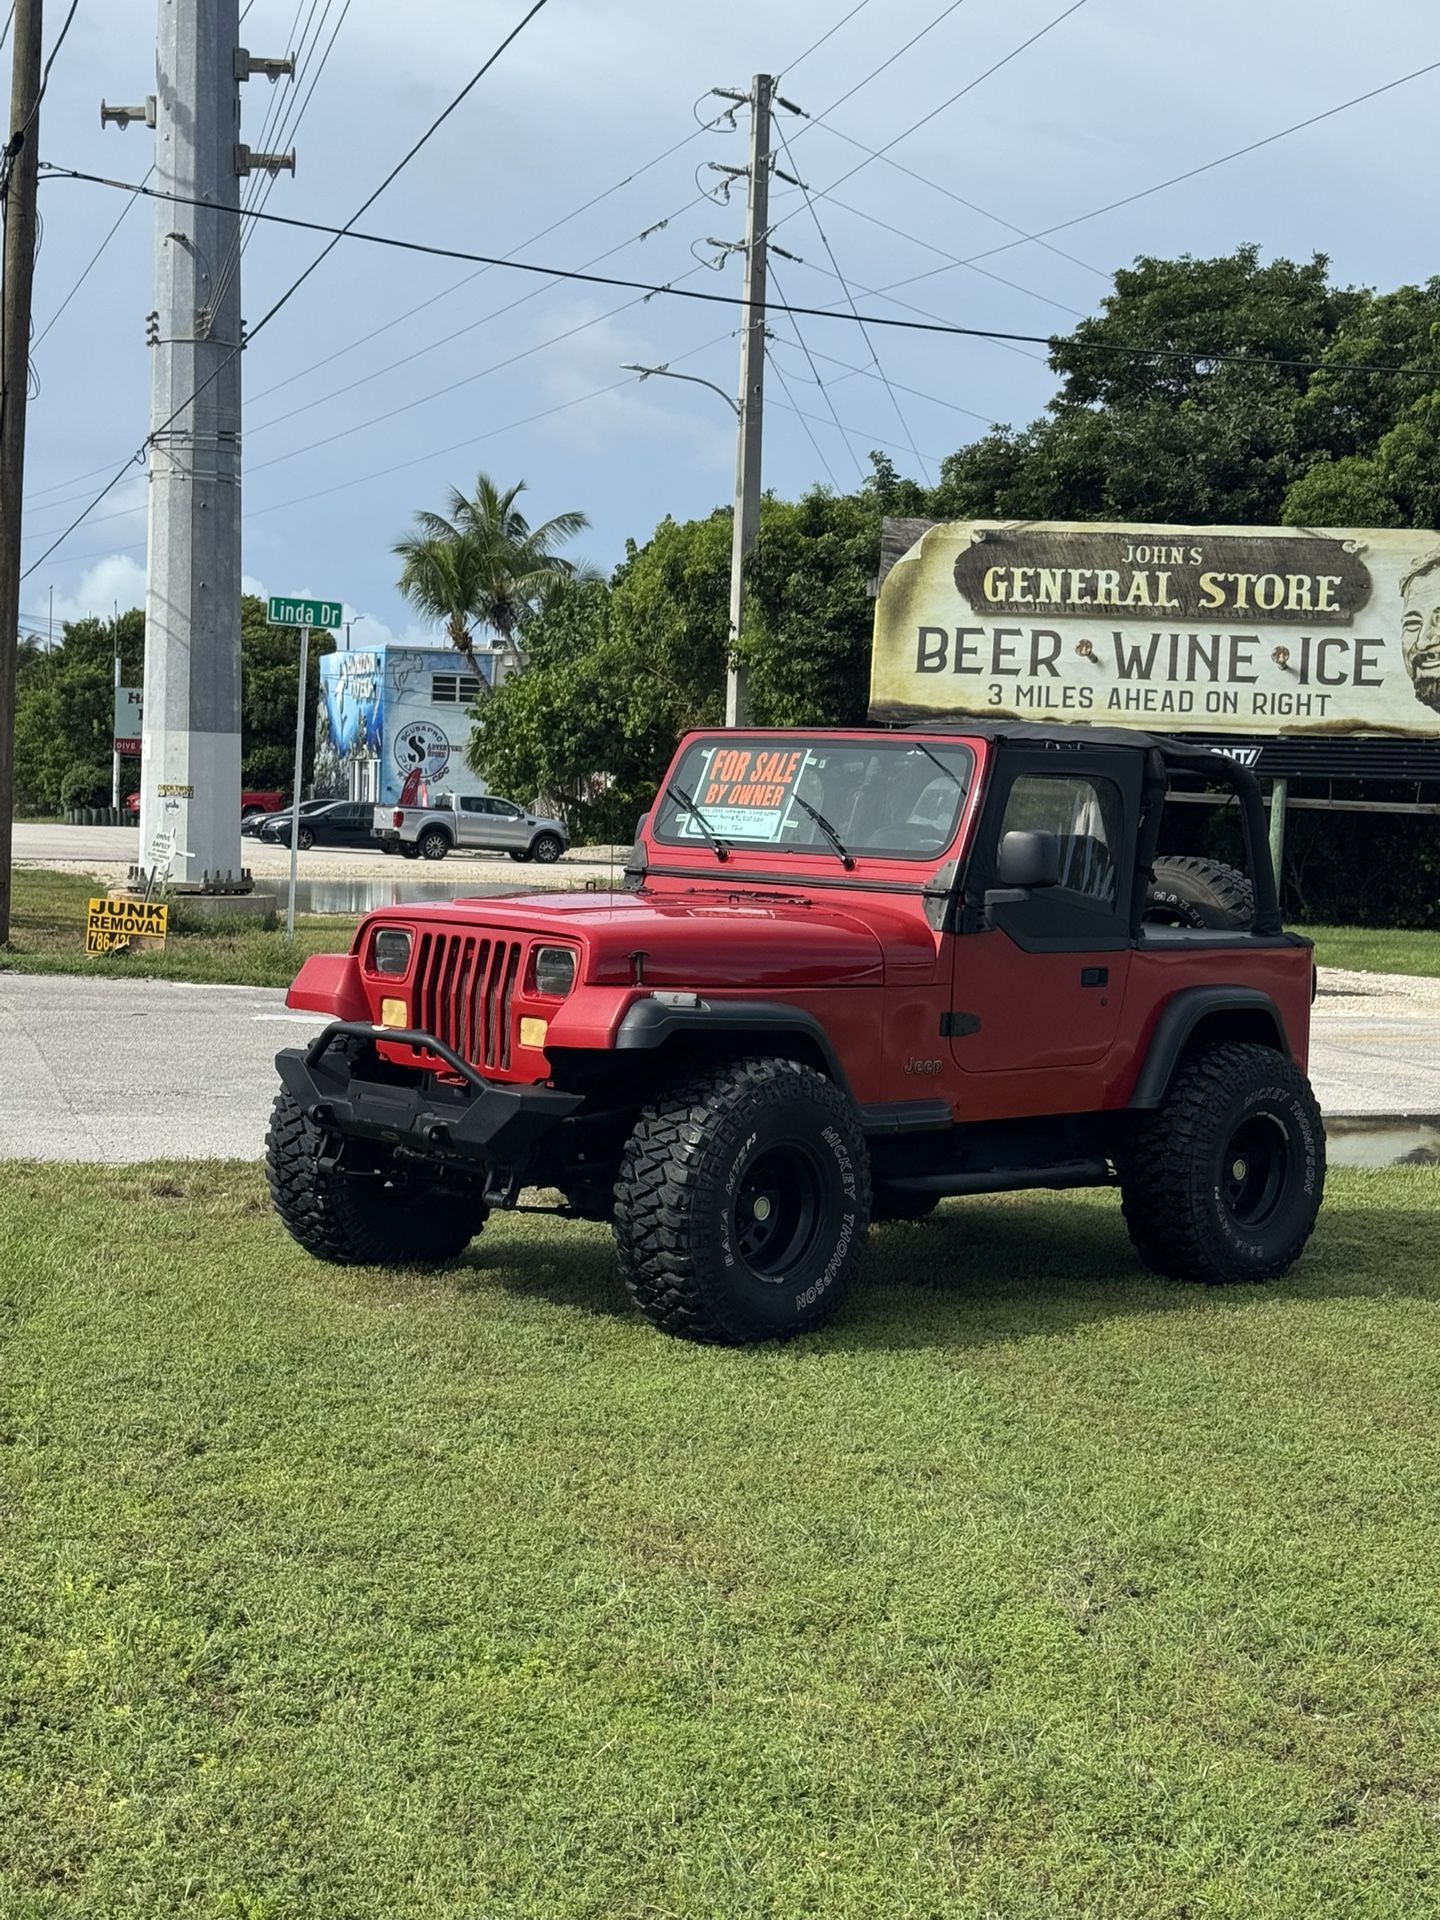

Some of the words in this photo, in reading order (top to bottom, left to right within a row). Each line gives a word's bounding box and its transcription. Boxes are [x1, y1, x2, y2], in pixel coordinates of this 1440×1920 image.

[1121, 544, 1203, 566] JOHN'S
[983, 565, 1180, 608] GENERAL
[1197, 570, 1343, 613] STORE
[270, 599, 314, 623] Linda
[320, 604, 340, 626] Dr
[914, 626, 1062, 678] BEER
[1111, 631, 1262, 685] WINE
[1297, 636, 1386, 688] ICE
[987, 682, 1003, 706] 3
[1015, 684, 1094, 709] MILES
[1107, 687, 1194, 713] AHEAD
[1205, 690, 1239, 714] ON
[1252, 692, 1333, 717] RIGHT
[116, 742, 136, 750] DIVE
[400, 725, 443, 742] SCUBAPRO
[709, 749, 752, 780] FOR
[750, 752, 802, 784] SALE
[704, 783, 729, 804] BY
[728, 784, 785, 807] OWNER
[89, 915, 165, 934] REMOVAL
[91, 901, 165, 920] JUNK
[904, 1056, 943, 1075] Jeep
[1243, 1086, 1291, 1110] MICKEY
[1288, 1100, 1317, 1196] THOMPSON
[820, 1125, 857, 1201] MICKEY
[720, 1207, 735, 1267] BAJA
[794, 1212, 856, 1311] THOMPSON
